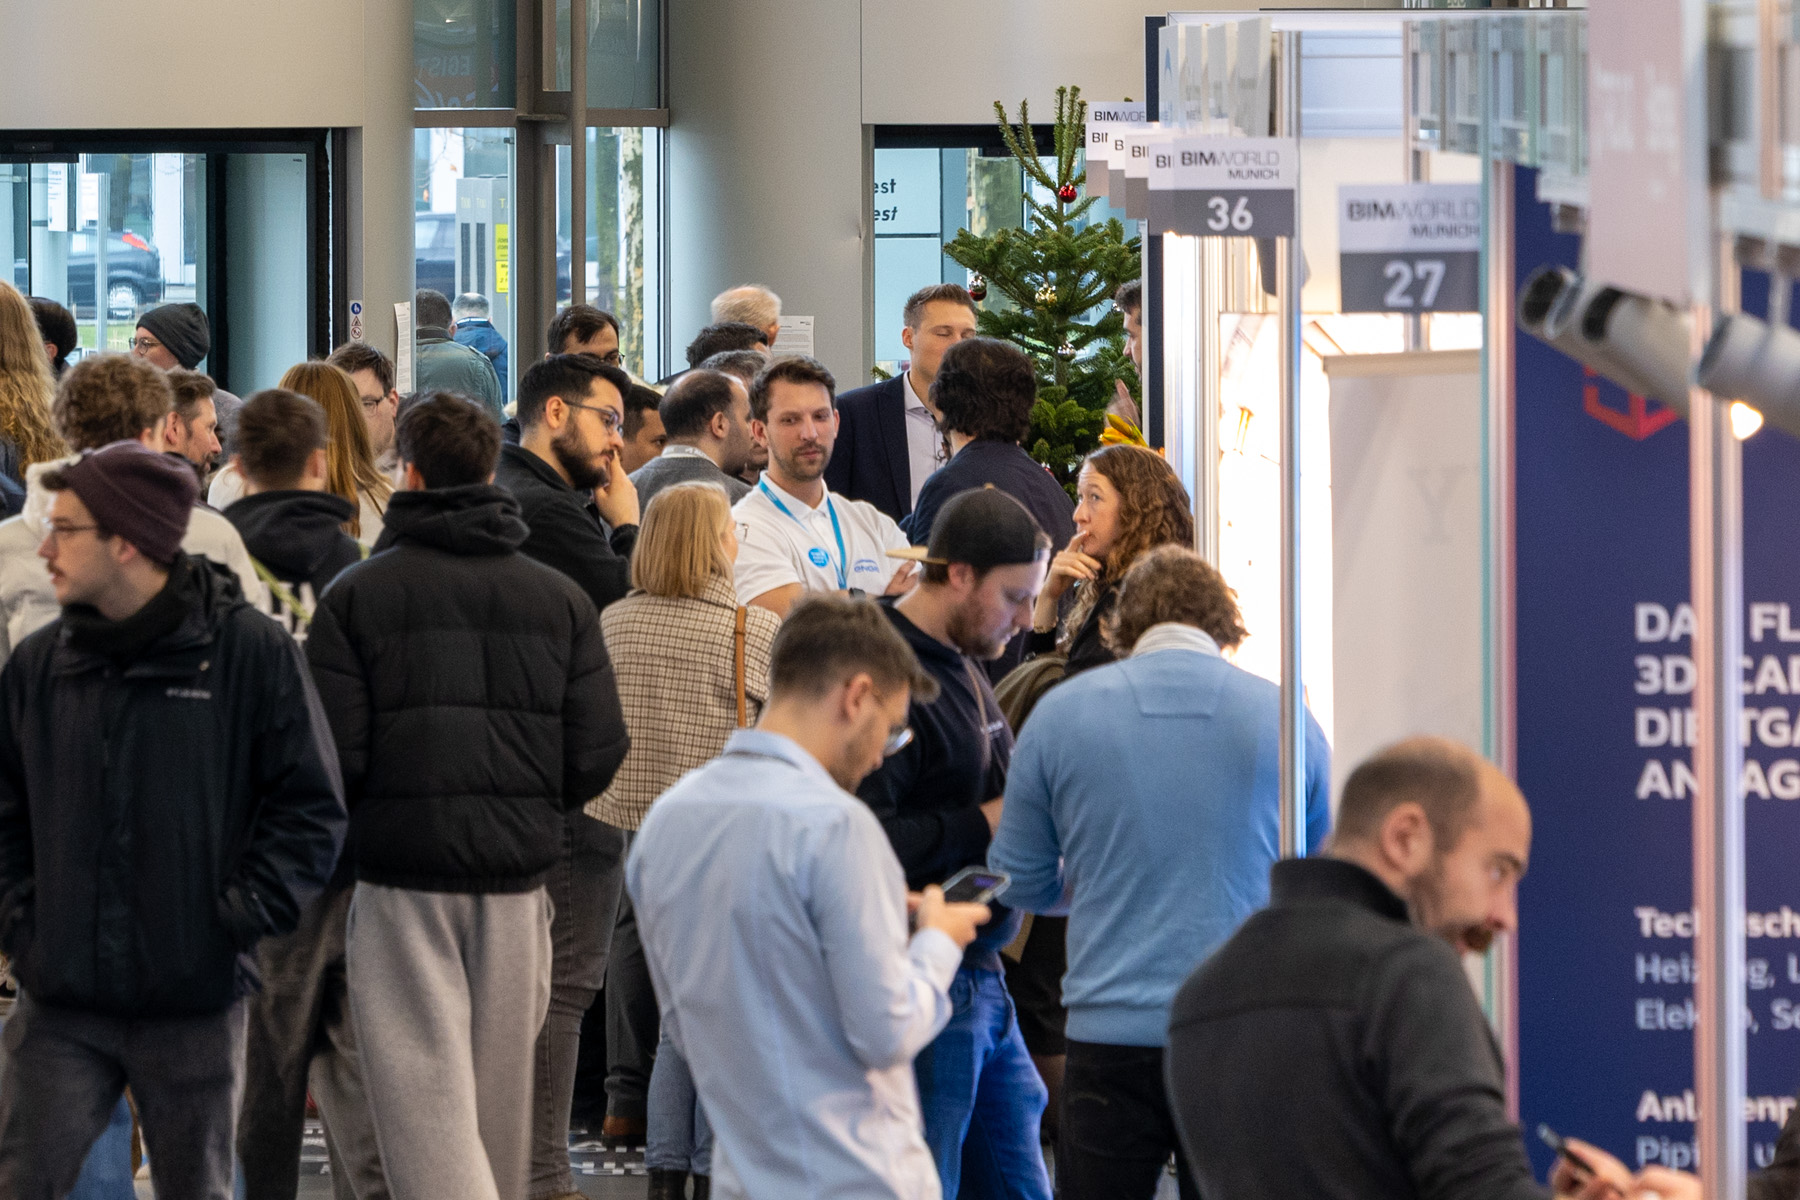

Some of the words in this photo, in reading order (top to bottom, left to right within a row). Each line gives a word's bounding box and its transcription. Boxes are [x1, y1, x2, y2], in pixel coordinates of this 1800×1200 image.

[1181, 150, 1280, 167] BIMWORLD
[1228, 169, 1280, 180] MUNICH
[1206, 196, 1253, 232] 36
[1382, 261, 1446, 308] 27
[1634, 602, 1700, 643] DA
